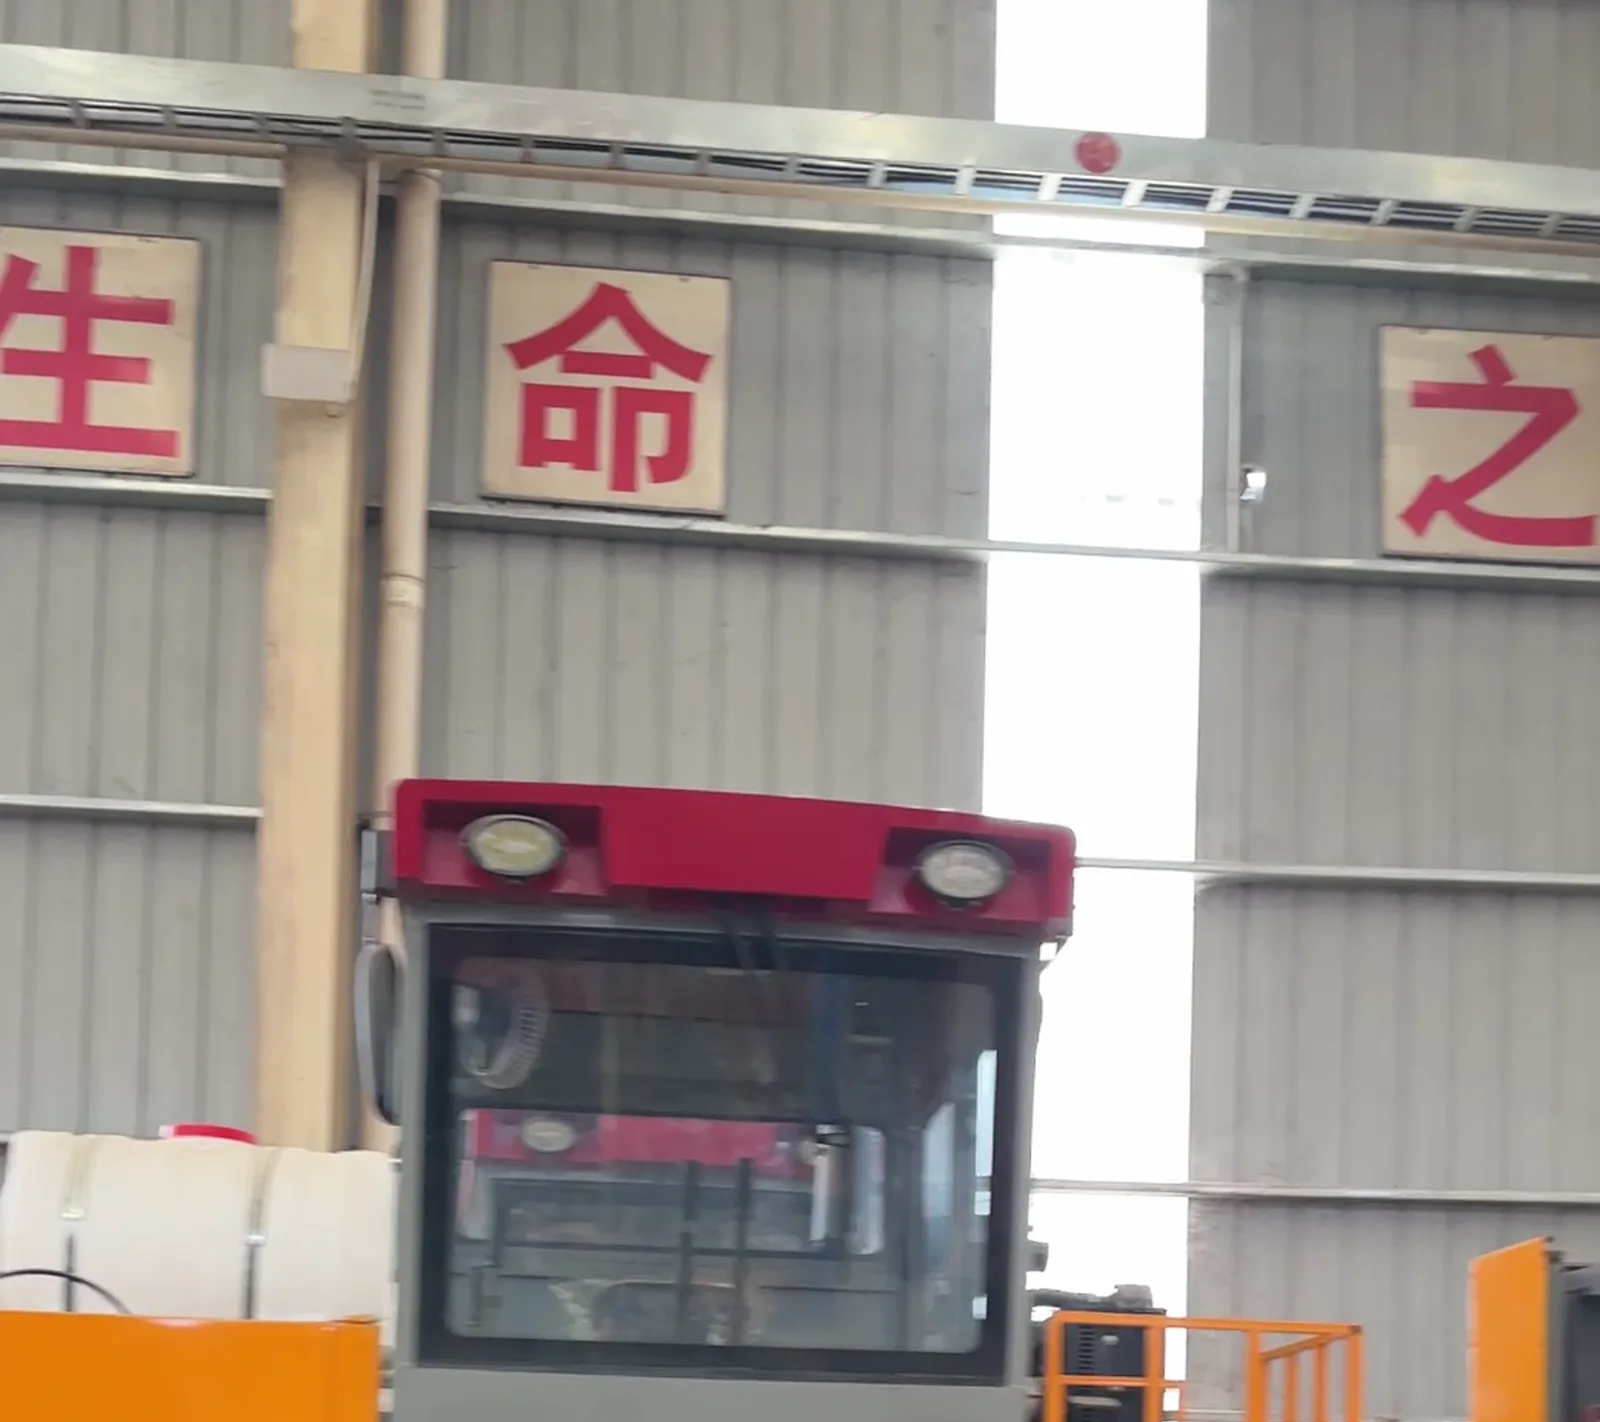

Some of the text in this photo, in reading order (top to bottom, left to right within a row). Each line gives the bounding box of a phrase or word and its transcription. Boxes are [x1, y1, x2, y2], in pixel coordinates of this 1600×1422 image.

[0, 245, 1597, 547] 生 命 之
